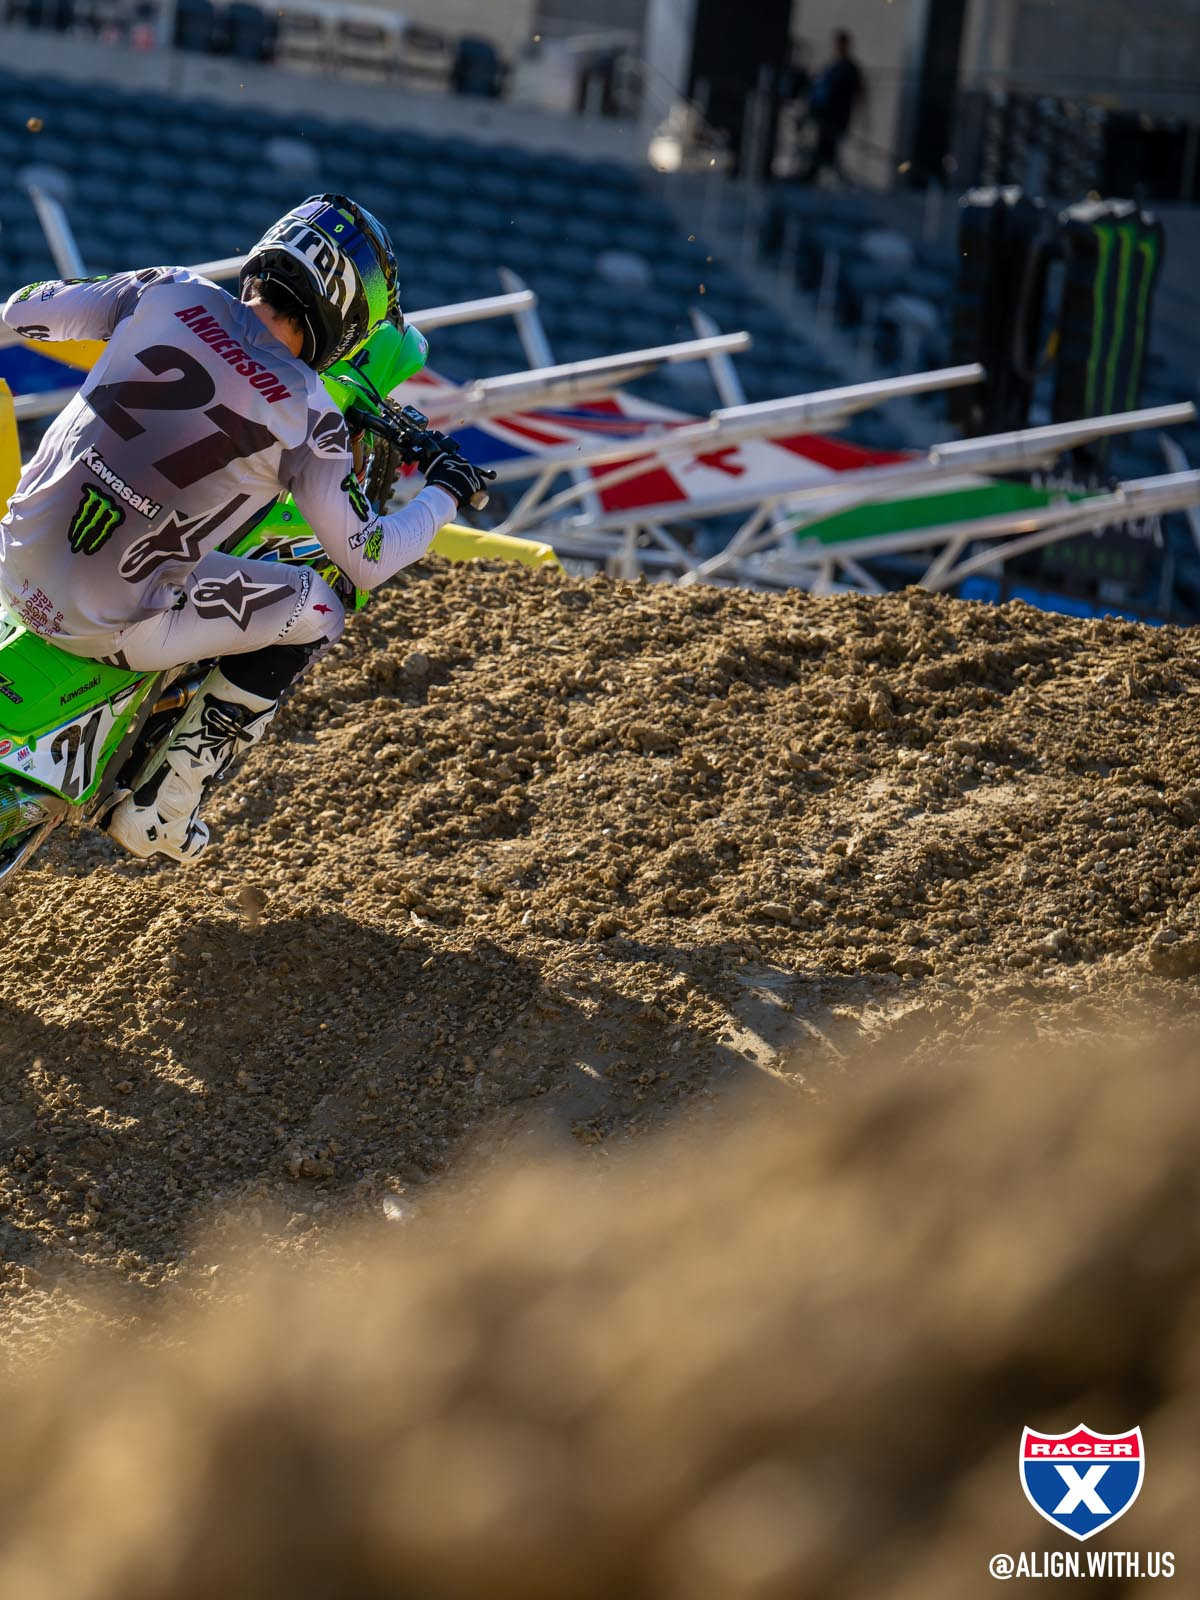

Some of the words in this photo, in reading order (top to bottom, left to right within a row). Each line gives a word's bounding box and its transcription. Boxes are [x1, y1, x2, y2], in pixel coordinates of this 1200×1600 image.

[174, 305, 292, 404] ANDERSON
[86, 344, 279, 489] 21
[81, 447, 161, 519] Kawasaki
[60, 675, 101, 706] Kawasaki
[51, 708, 105, 800] 21
